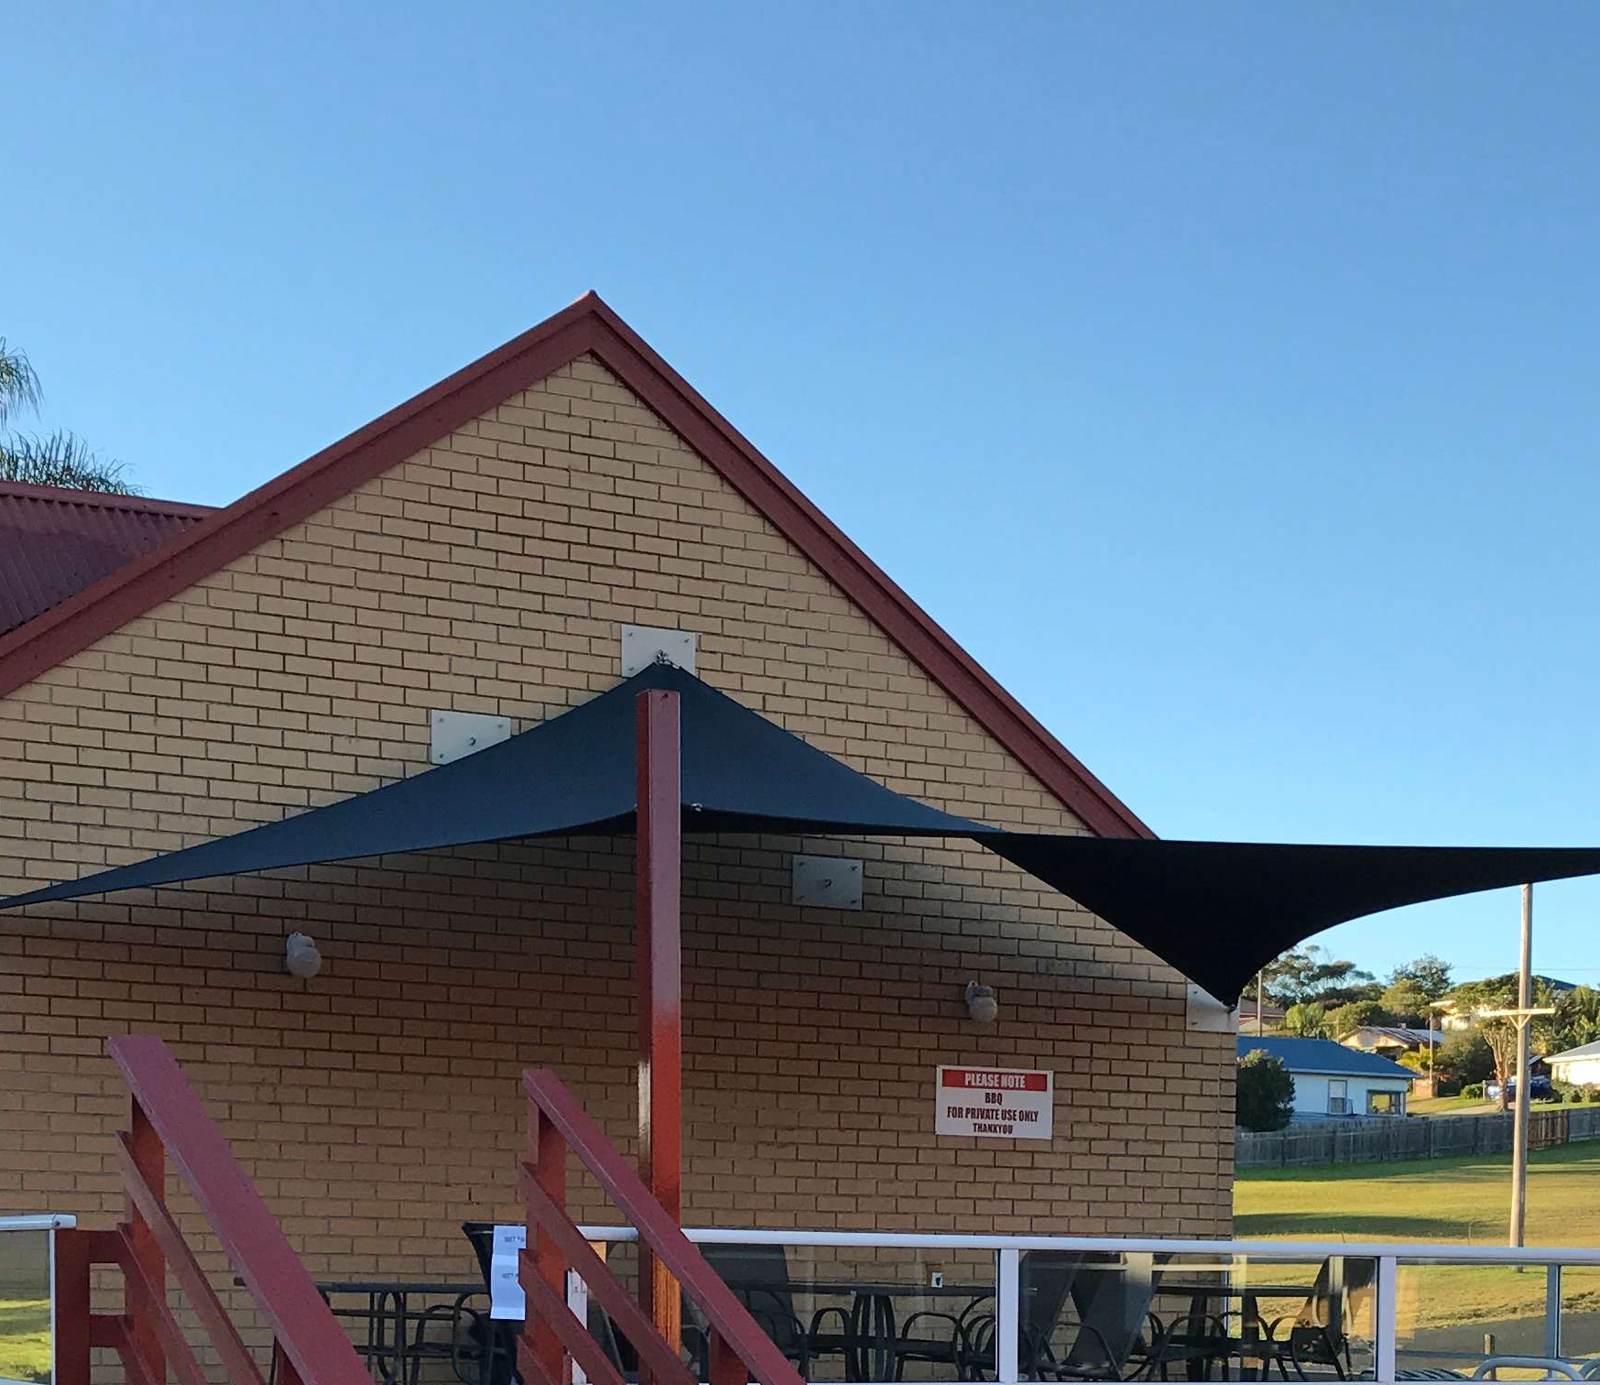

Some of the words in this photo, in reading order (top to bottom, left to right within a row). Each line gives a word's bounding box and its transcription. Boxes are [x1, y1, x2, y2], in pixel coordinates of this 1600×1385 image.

[965, 1073, 999, 1087] PLEASE
[1001, 1075, 1025, 1088] NOTE
[985, 1093, 1003, 1105] BBQ
[947, 1106, 963, 1118] FOR
[965, 1108, 999, 1120] PRIVATE
[1001, 1110, 1017, 1121] USE
[1019, 1110, 1038, 1122] ONLY
[973, 1123, 1013, 1134] THANKYOU
